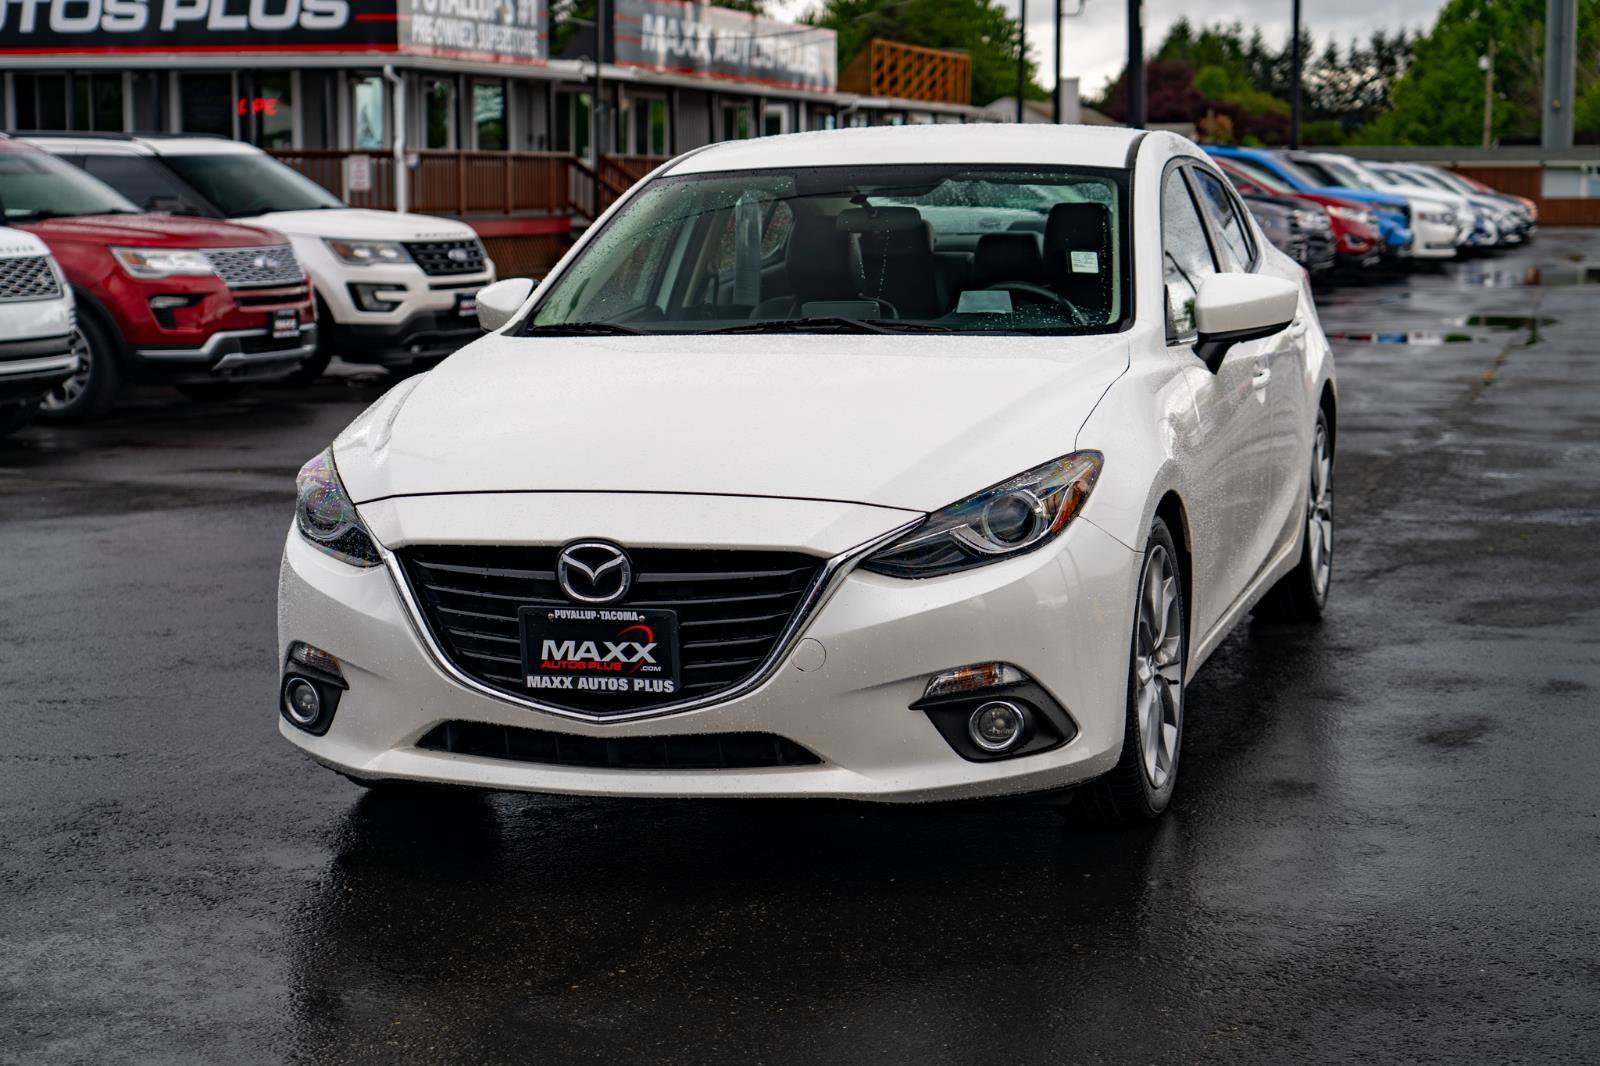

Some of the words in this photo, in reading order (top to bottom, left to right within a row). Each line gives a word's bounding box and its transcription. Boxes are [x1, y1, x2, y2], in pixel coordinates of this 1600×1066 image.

[160, 0, 349, 31] PLUS
[641, 13, 711, 64] MAXX
[541, 640, 658, 663] MAXX
[541, 660, 585, 669] AUTOS
[588, 661, 622, 671] PLUS
[526, 675, 573, 689] MAXX
[578, 677, 629, 691] AUTOS
[633, 679, 674, 692] PLUS
